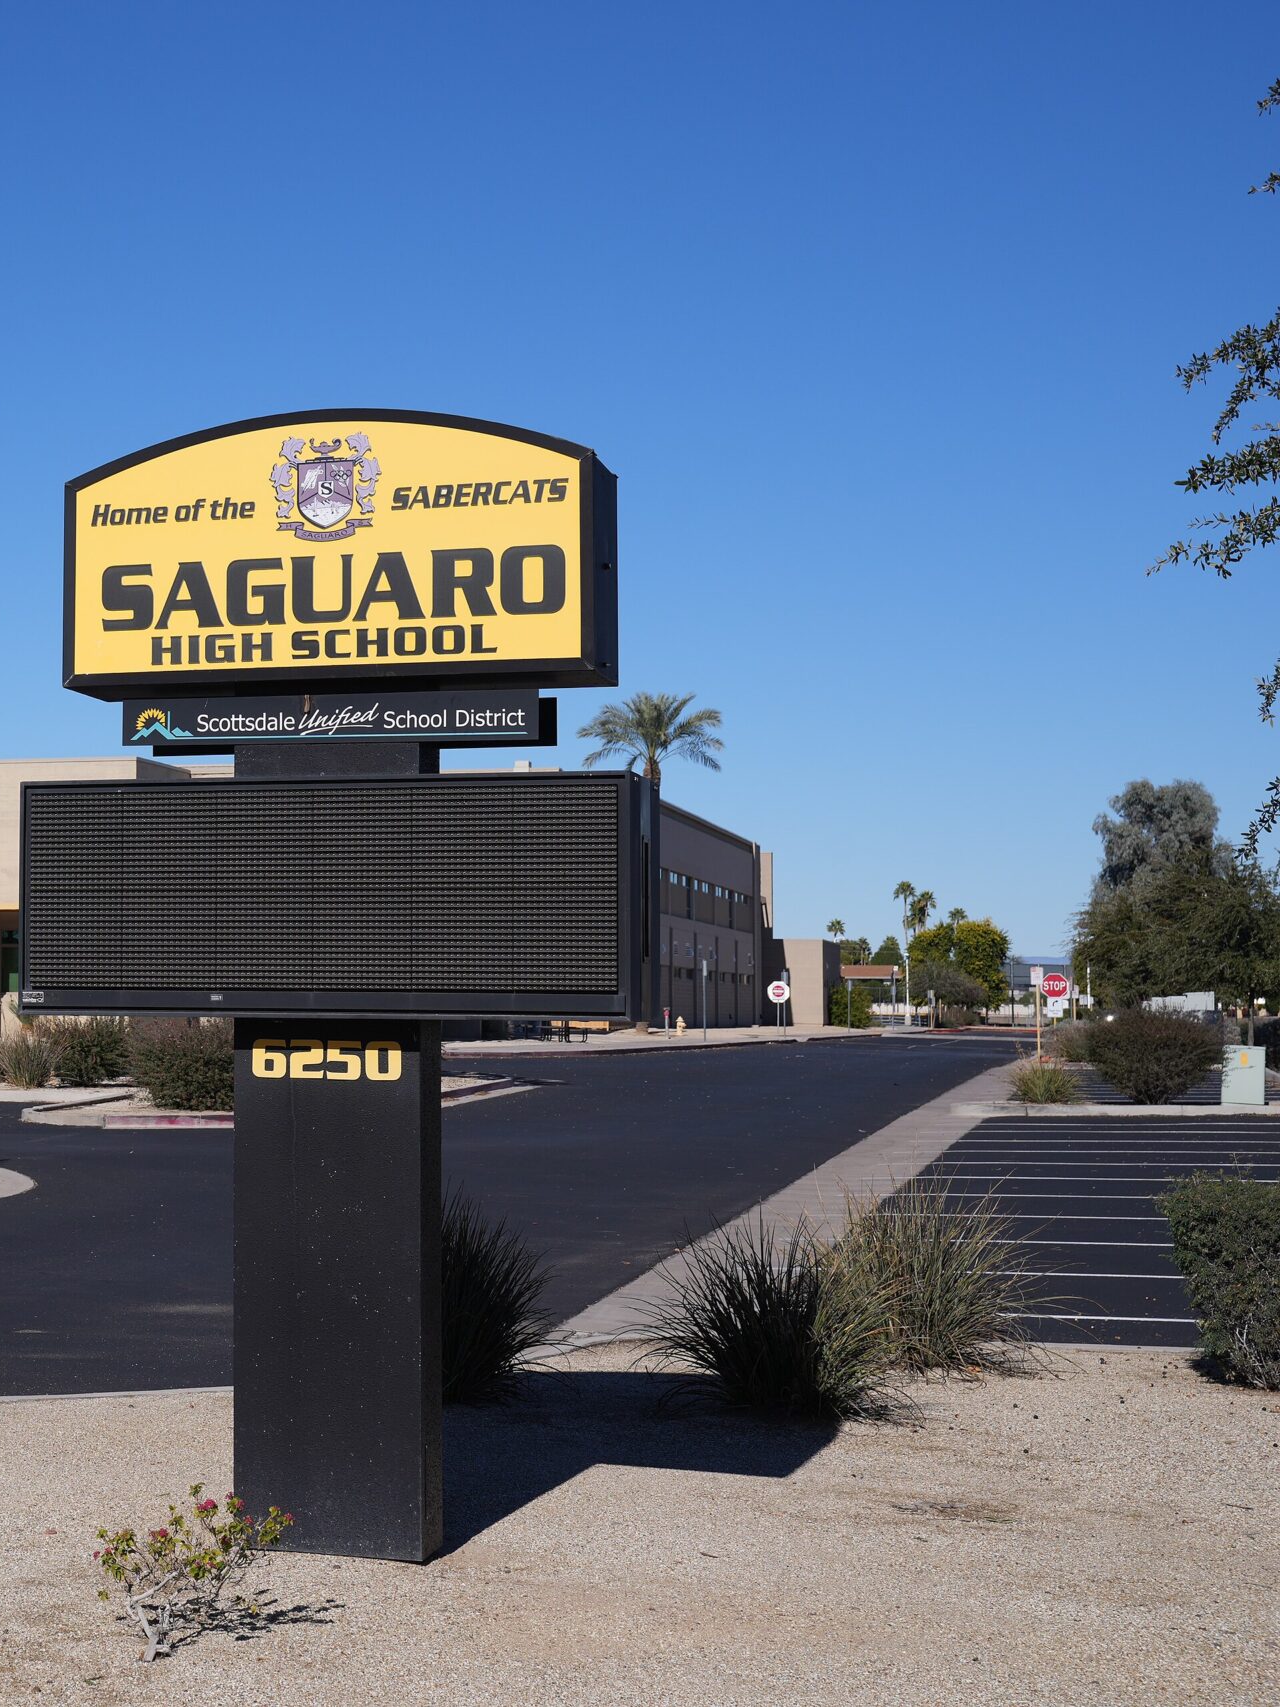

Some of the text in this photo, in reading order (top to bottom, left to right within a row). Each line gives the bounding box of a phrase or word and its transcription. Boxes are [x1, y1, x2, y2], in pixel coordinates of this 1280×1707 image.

[320, 482, 332, 495] S
[391, 478, 568, 511] SABERCATS
[91, 497, 255, 527] Home of the
[301, 530, 348, 539] SAGUARO
[101, 544, 565, 632] SAGUARO
[151, 624, 498, 665] HIGH SCHOOL
[196, 702, 525, 736] Scottsdale Unified School District
[1043, 981, 1066, 991] STOP
[251, 1038, 402, 1081] 6250
